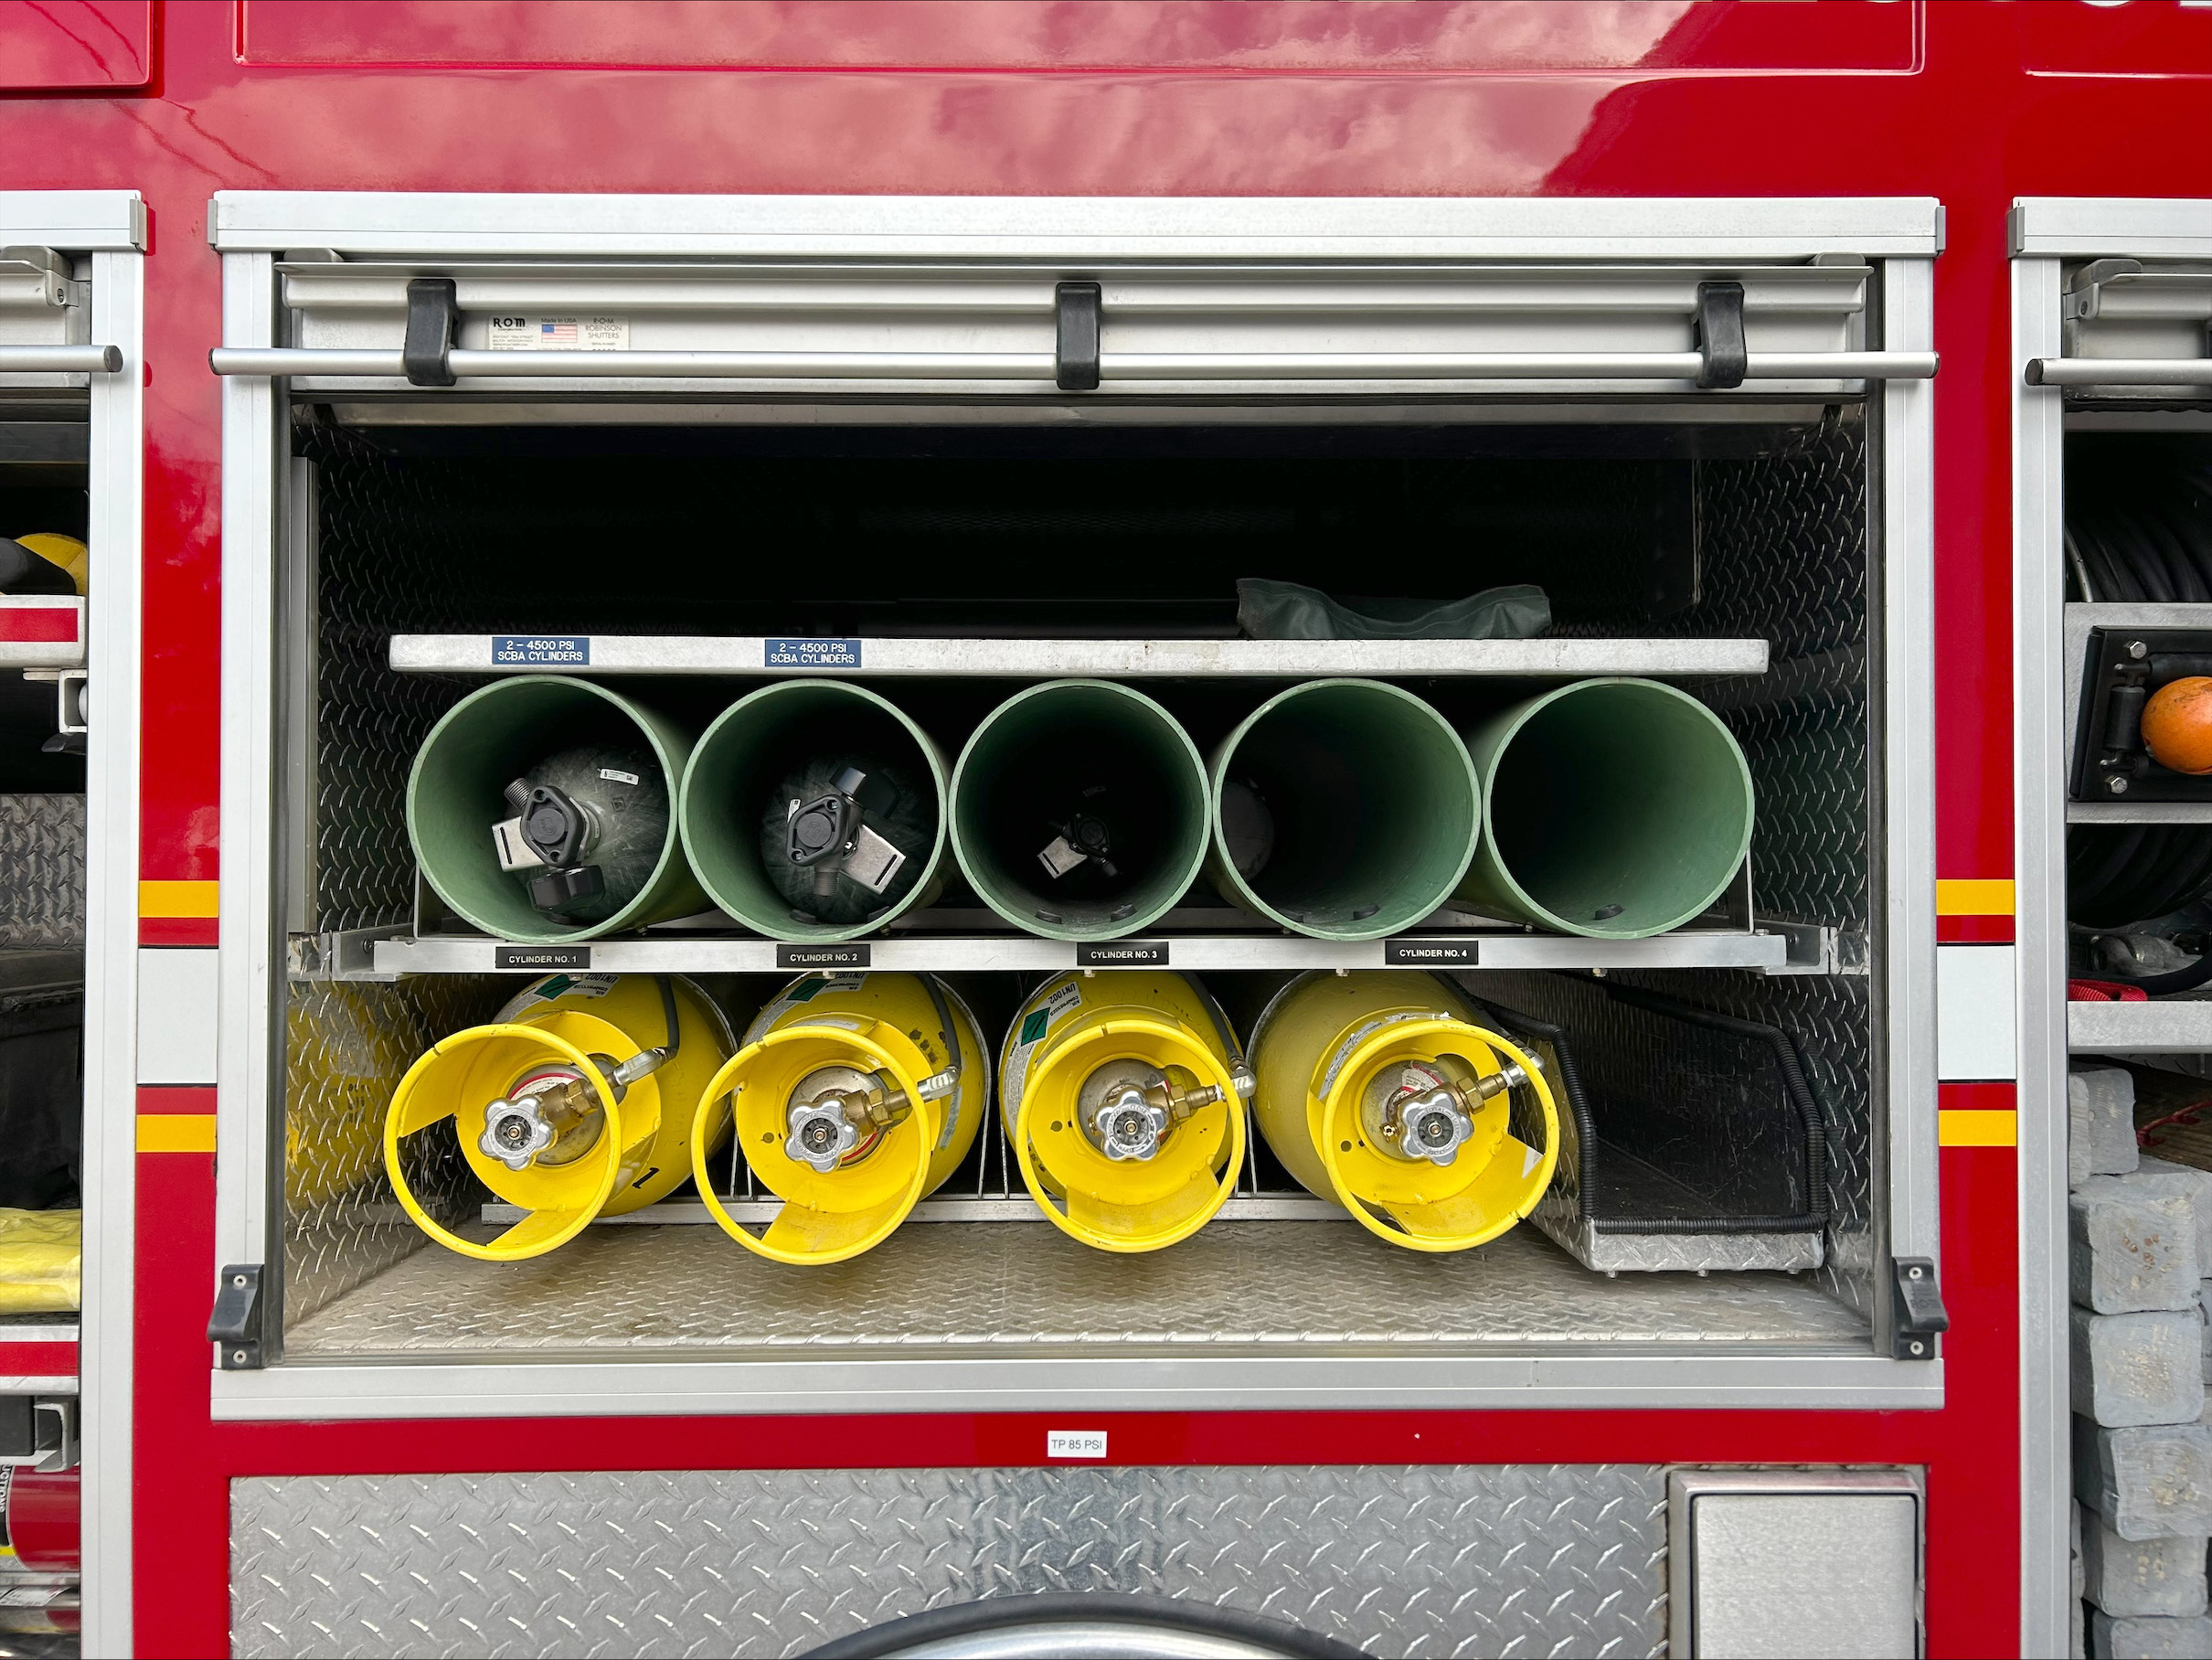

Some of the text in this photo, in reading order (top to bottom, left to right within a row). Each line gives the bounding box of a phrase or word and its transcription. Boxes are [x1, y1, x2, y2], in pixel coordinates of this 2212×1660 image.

[506, 640, 514, 650] 2
[526, 640, 556, 650] 4500
[558, 640, 575, 650] PSI
[779, 643, 786, 653] 2
[799, 643, 828, 653] 4500
[831, 643, 846, 653] PSI
[497, 651, 583, 661] SCBA CYLINDERS
[771, 654, 856, 664] SCBA CYLINDERS
[790, 953, 833, 962] CYLINDER
[852, 952, 858, 961] 2
[1090, 951, 1157, 959] CYLINDER NO. 3
[1398, 949, 1467, 957] CYLINDER NO. 4
[508, 955, 553, 963] CYLINDER
[1048, 983, 1077, 1004] UN1002
[632, 1166, 660, 1189] 1
[1051, 1439, 1102, 1450] TP 85 PSI
